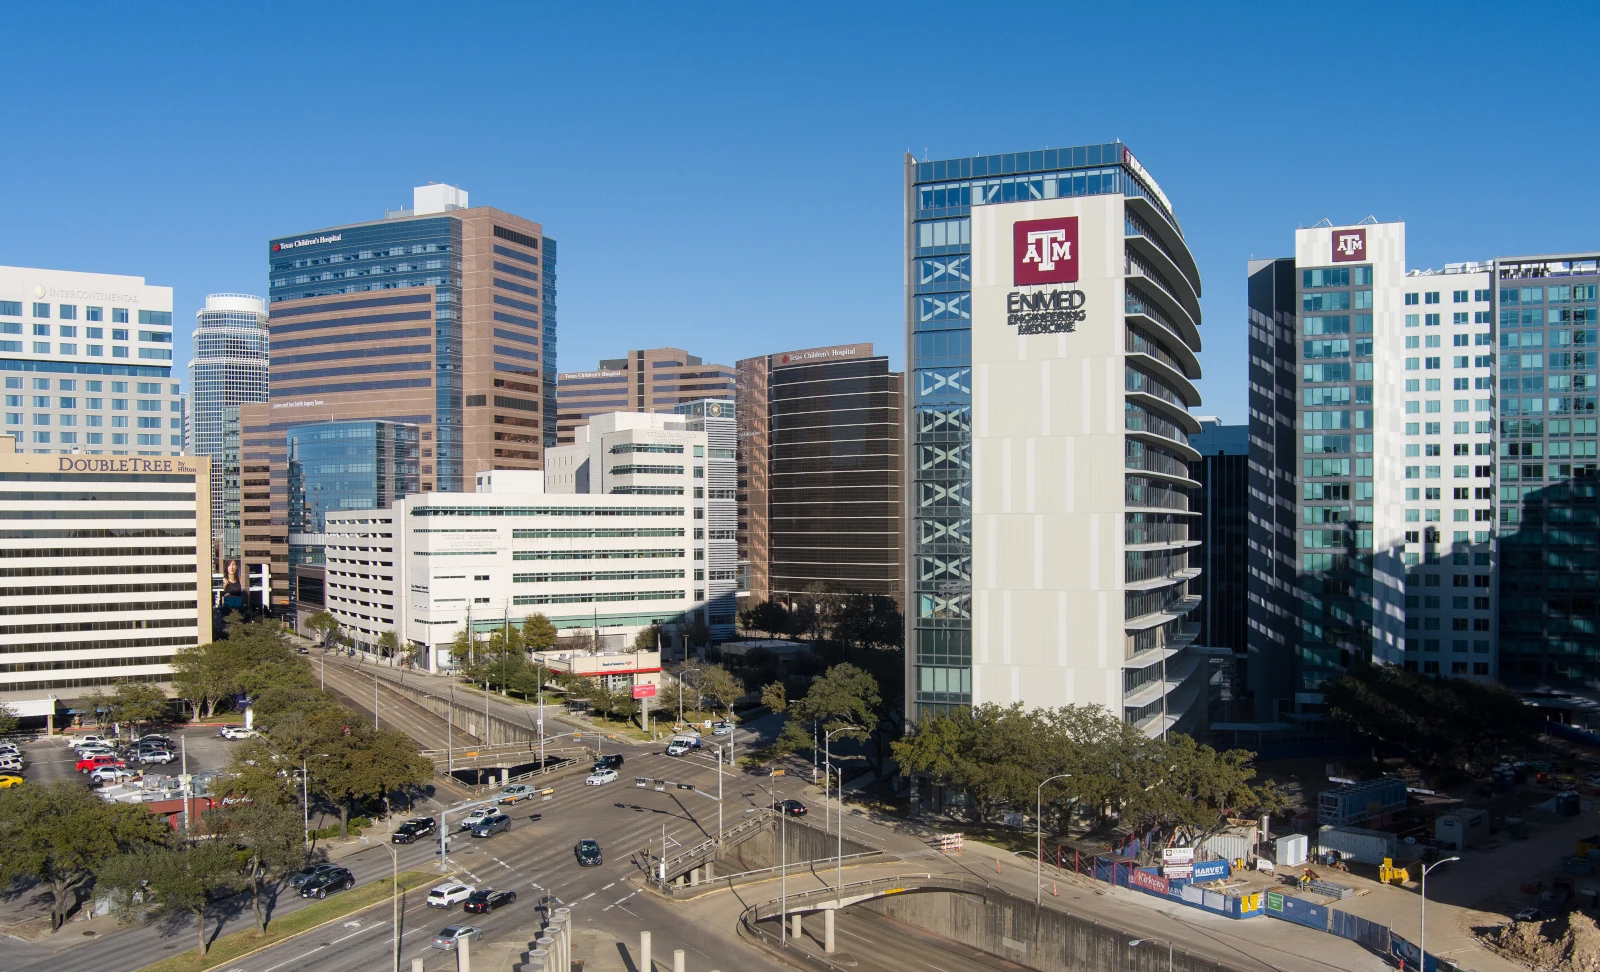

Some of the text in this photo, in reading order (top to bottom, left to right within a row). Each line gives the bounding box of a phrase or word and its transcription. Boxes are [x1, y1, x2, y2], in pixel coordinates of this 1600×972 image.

[280, 233, 342, 250] Texas Children's Hospital
[1007, 310, 1087, 326] ENGINEERING
[1018, 321, 1077, 336] MEDICINE
[804, 350, 830, 359] Children's
[832, 348, 856, 357] Hospital
[578, 371, 601, 379] Children's
[602, 370, 621, 378] Hospital
[1195, 866, 1225, 876] HARVEY
